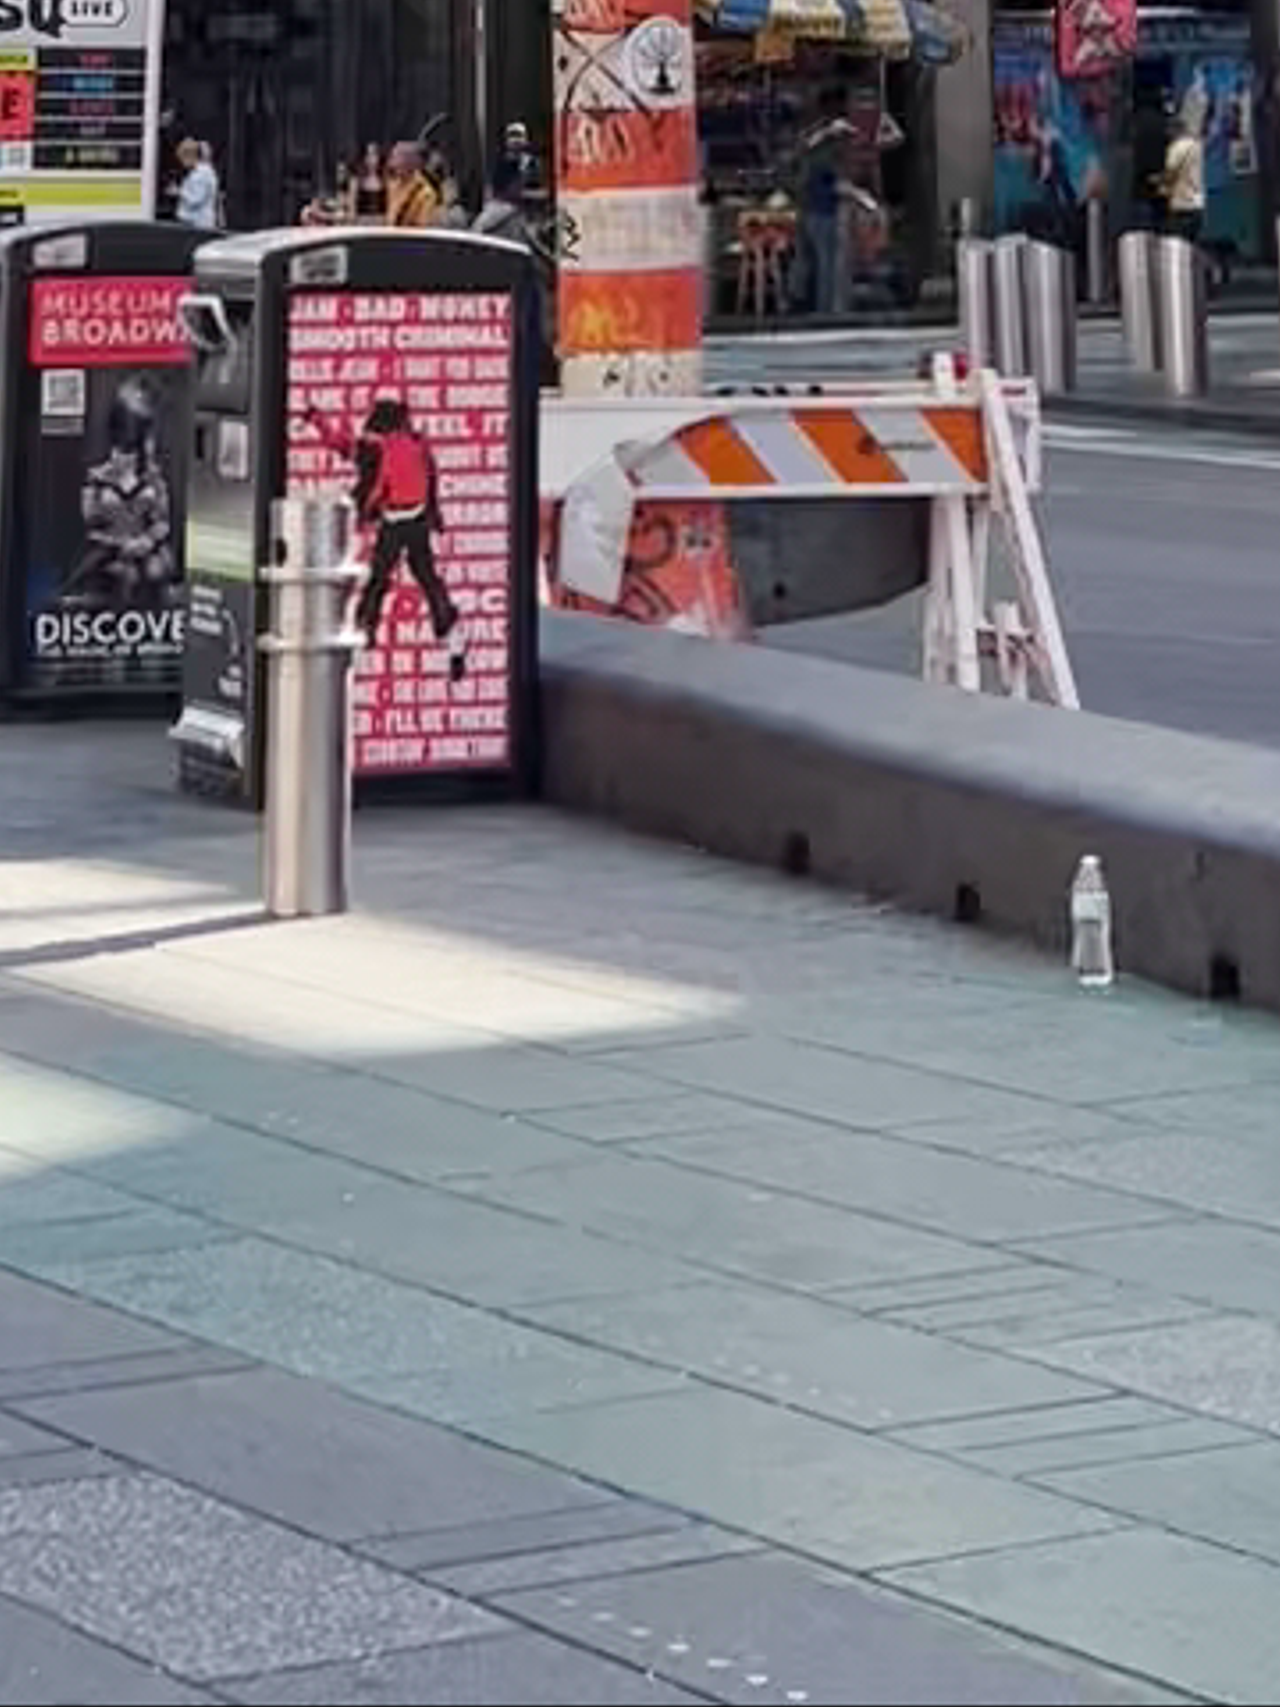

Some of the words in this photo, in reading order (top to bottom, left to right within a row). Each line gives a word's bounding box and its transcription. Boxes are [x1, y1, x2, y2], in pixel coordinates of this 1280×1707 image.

[69, 0, 115, 17] LIVE
[41, 289, 172, 319] MUSEUM
[353, 293, 406, 322] BAD
[421, 292, 511, 322] MONEY
[35, 609, 187, 646] DISCOVE
